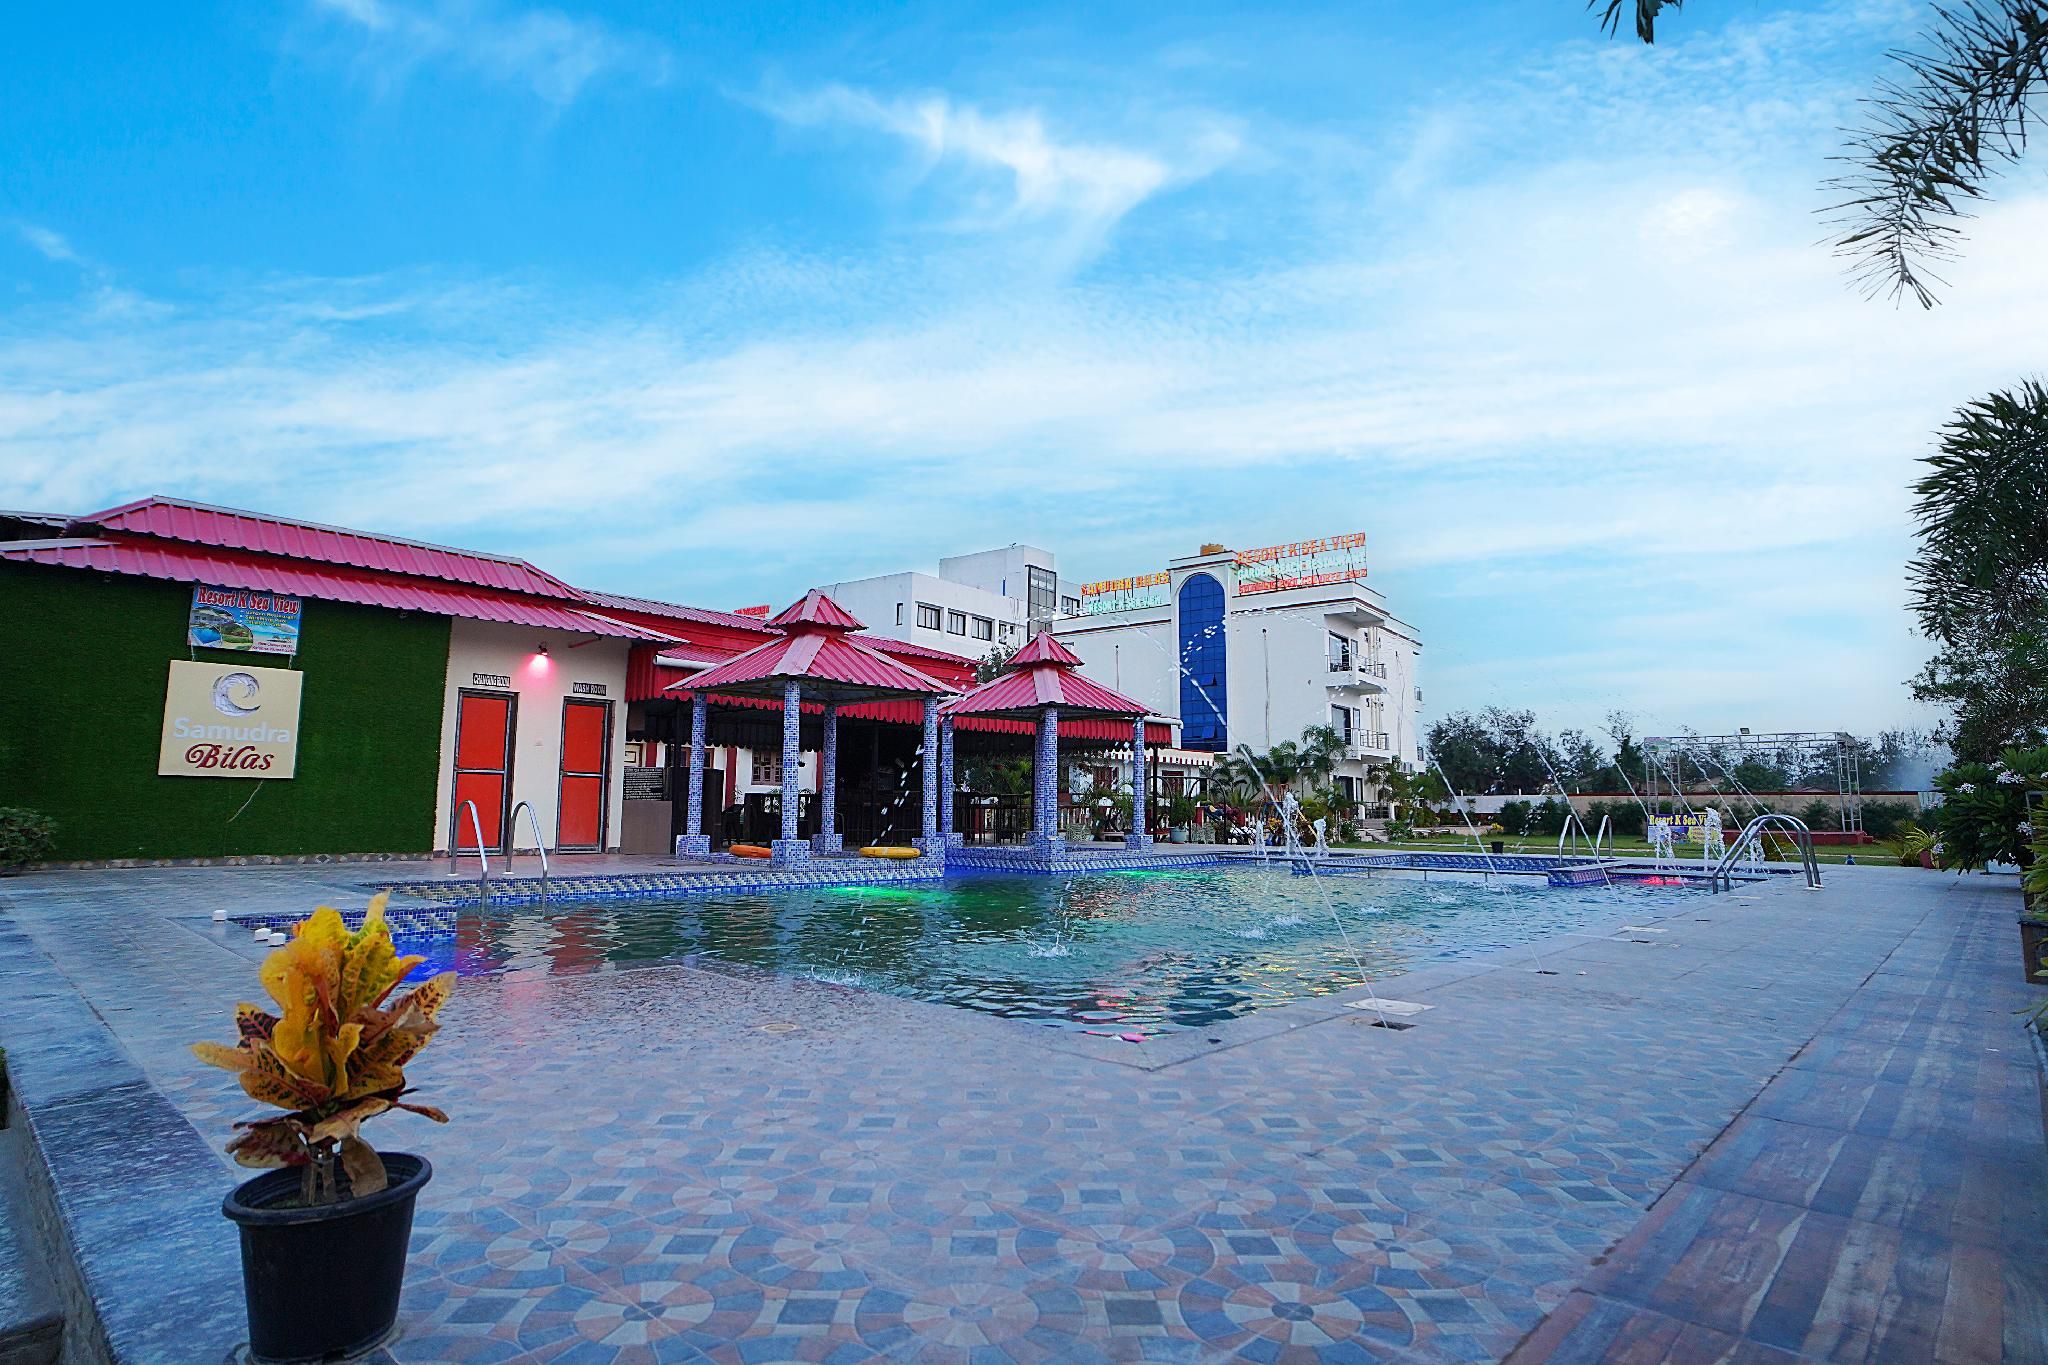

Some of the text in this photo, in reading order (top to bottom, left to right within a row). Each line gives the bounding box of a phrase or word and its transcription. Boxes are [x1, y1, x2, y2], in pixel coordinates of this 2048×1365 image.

[1301, 538, 1327, 556] SEA
[1331, 532, 1366, 550] VIEW
[1081, 571, 1169, 596] SAMUDRA BILAS
[197, 586, 300, 614] Resort K Sea View
[1088, 600, 1116, 614] RESORT
[473, 674, 510, 687] CHANGING ROOM
[573, 683, 606, 695] WASH ROOM
[173, 716, 291, 744] Samudra
[185, 743, 275, 770] Bilas
[1674, 814, 1682, 825] K
[1683, 814, 1697, 825] Sea
